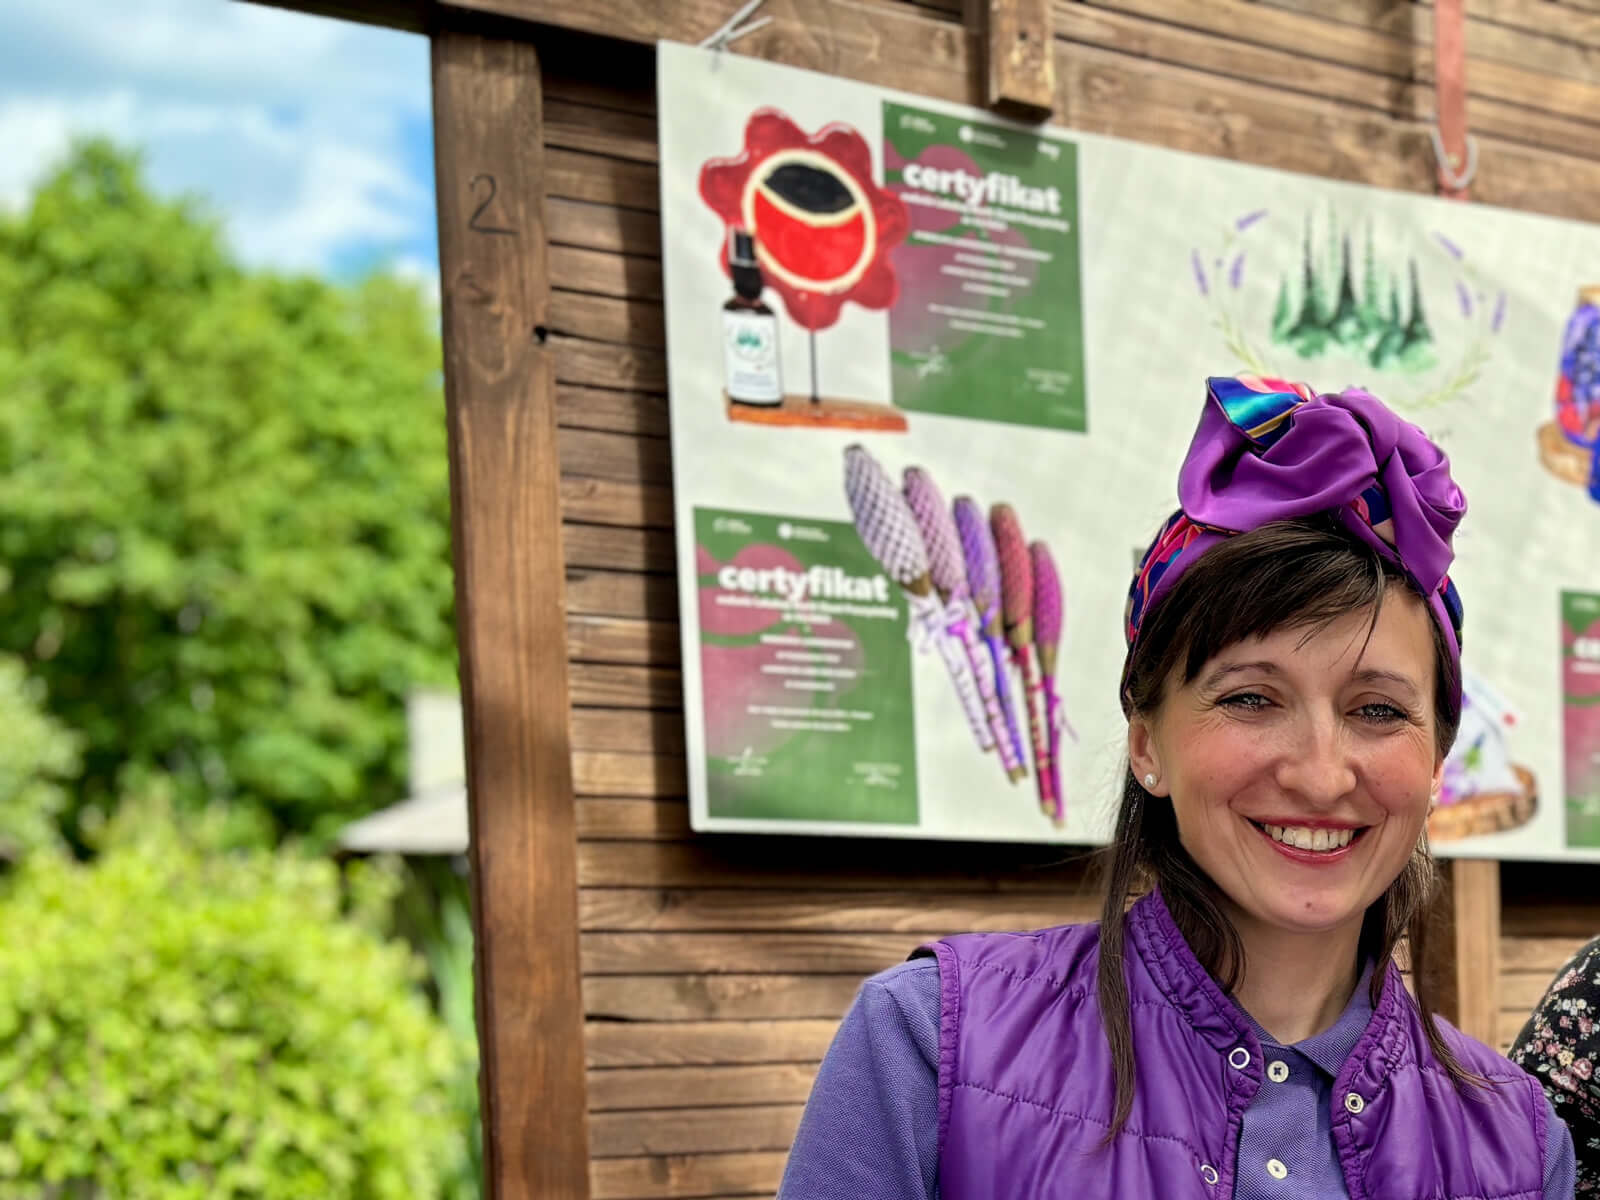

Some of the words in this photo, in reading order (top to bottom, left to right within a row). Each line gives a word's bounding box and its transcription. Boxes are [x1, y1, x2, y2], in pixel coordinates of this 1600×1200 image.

[467, 173, 521, 237] 2
[902, 163, 1061, 214] certyfikat
[718, 564, 889, 603] certyfikat
